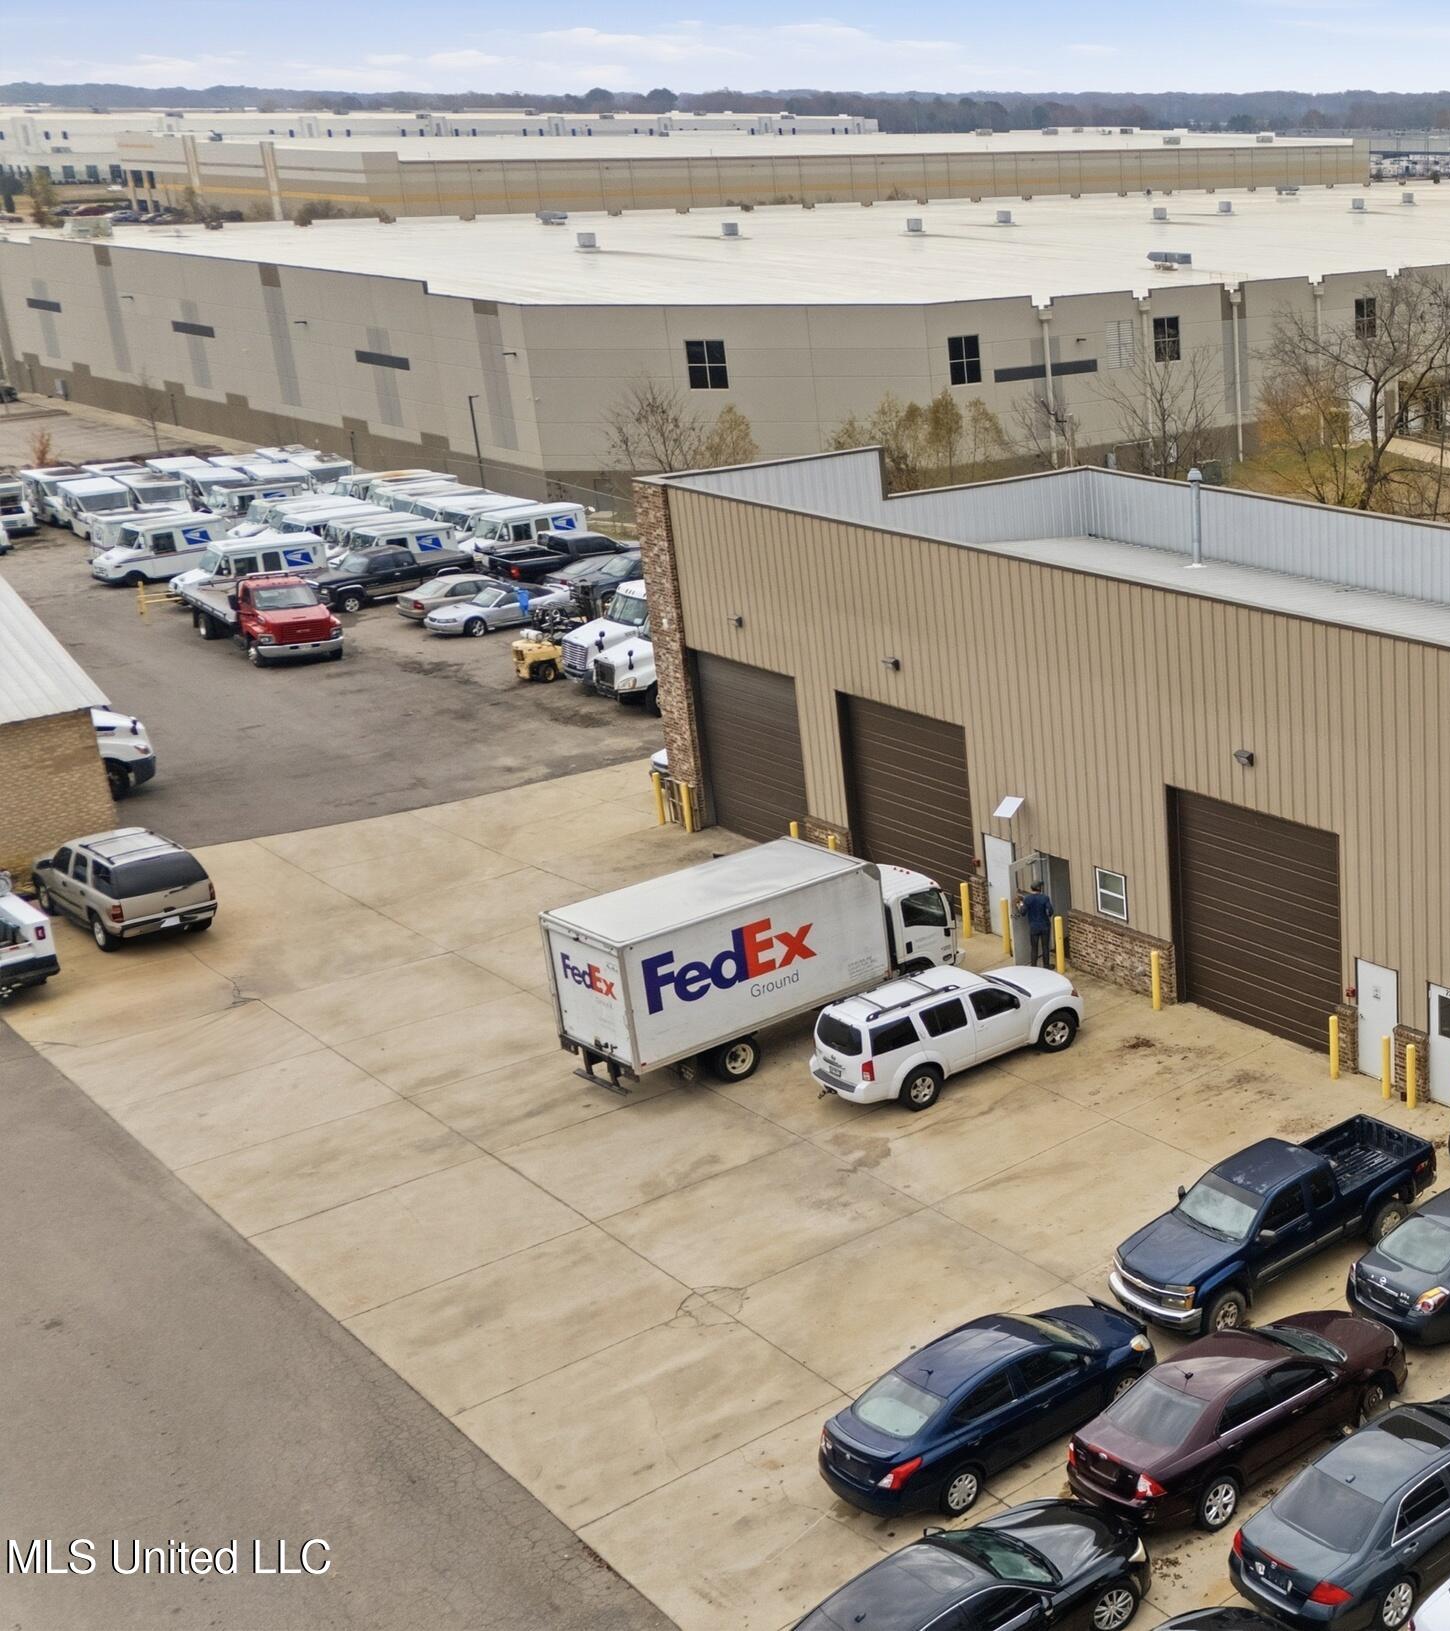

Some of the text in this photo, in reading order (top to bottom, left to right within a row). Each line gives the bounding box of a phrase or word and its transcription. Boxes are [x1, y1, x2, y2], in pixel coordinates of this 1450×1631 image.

[560, 952, 617, 1000] FedEx
[641, 917, 817, 1015] FedEx
[750, 969, 800, 998] Ground
